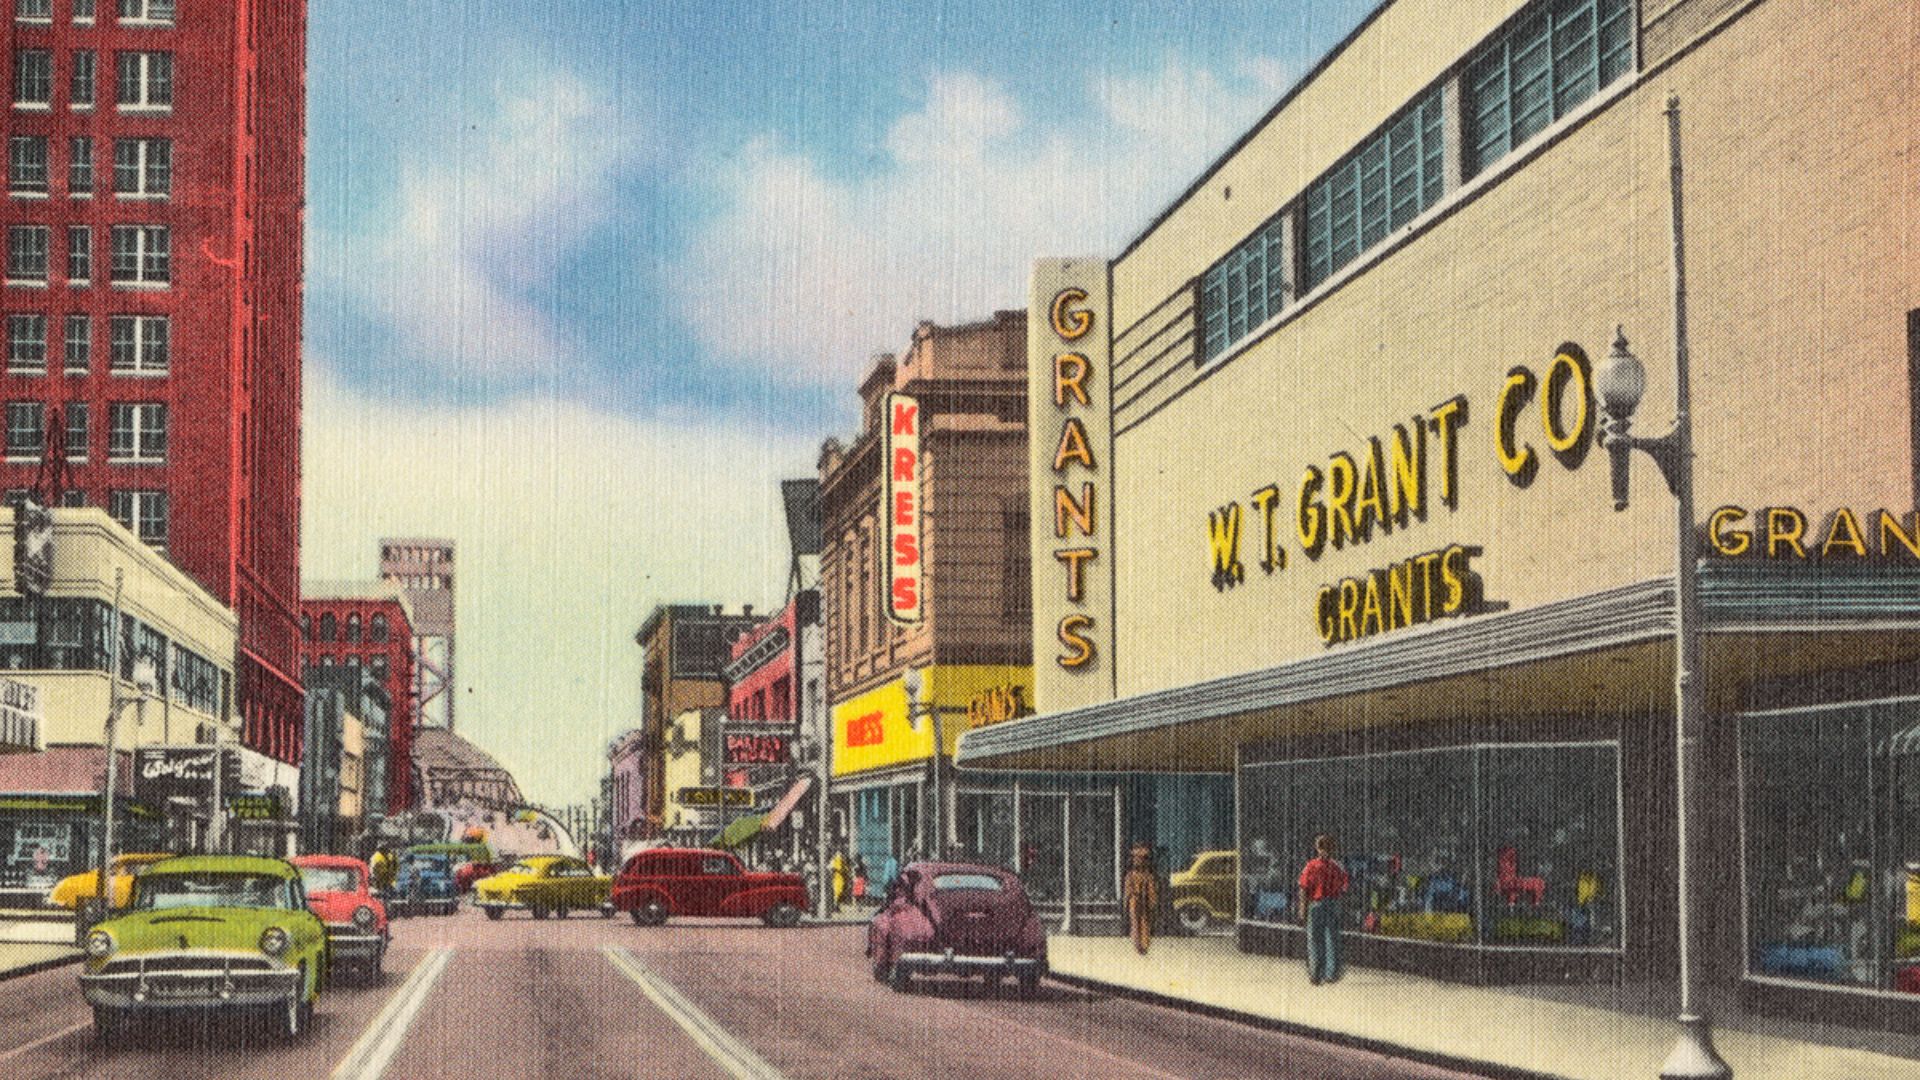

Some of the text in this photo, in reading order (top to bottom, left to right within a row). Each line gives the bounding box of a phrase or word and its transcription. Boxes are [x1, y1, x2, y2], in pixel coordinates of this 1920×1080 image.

[891, 403, 919, 611] KRESS
[1050, 288, 1098, 671] GRANTS
[1253, 484, 1287, 573] T.
[1297, 396, 1467, 557] GRANT
[1494, 344, 1594, 486] CO
[1708, 505, 1920, 560] GRAN
[1314, 544, 1468, 647] GRANTS
